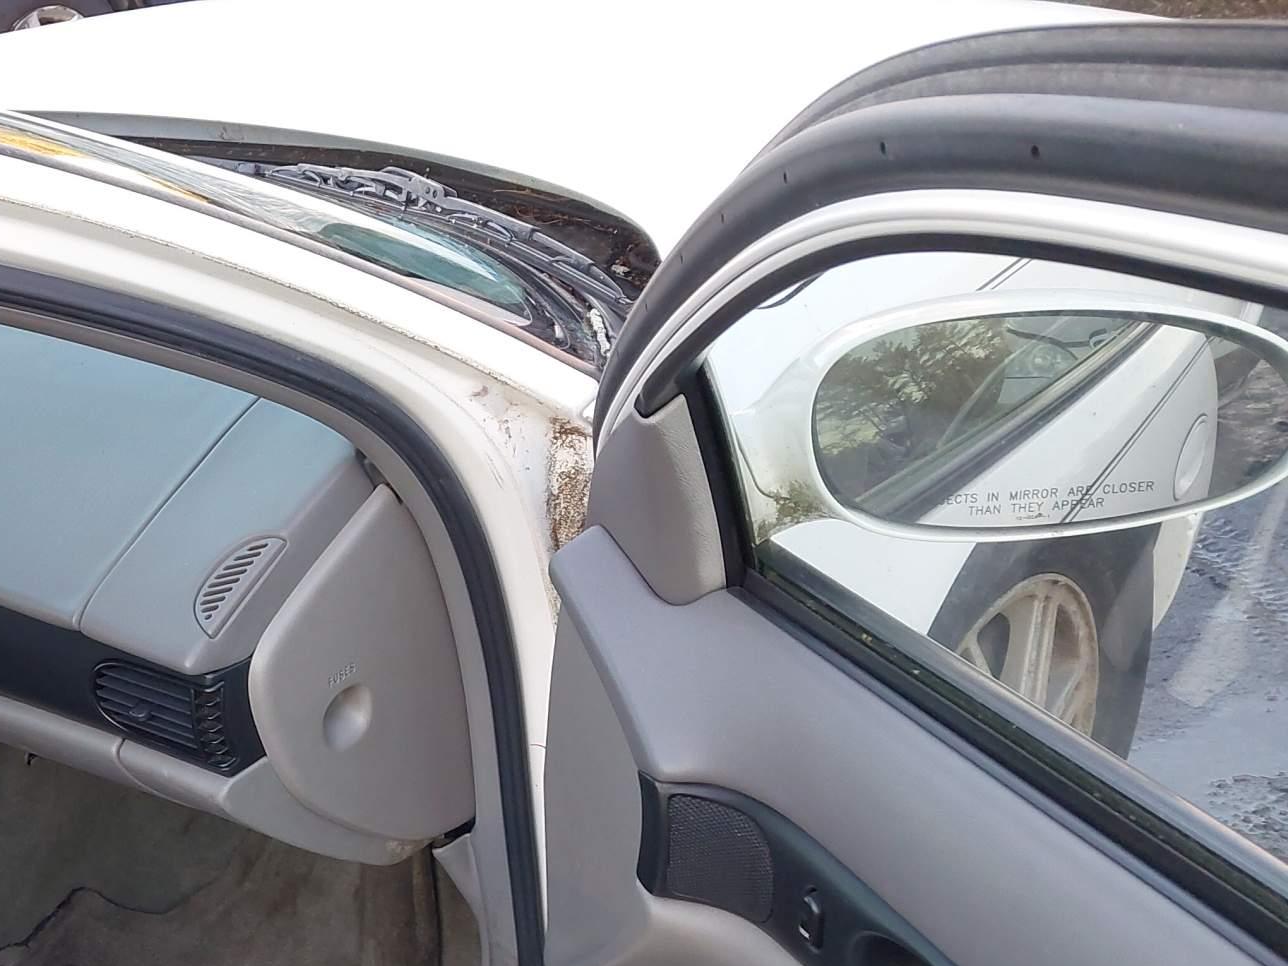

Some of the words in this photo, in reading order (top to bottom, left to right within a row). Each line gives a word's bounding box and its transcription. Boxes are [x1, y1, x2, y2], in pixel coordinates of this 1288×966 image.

[938, 493, 978, 506] ECTS
[987, 491, 999, 502] IN
[1008, 487, 1058, 501] MIRROR
[1067, 485, 1093, 496] ARE
[1102, 480, 1155, 495] CLOSER
[968, 504, 1002, 517] THAN
[1011, 501, 1044, 512] THEY
[1052, 497, 1105, 511] APPEAR
